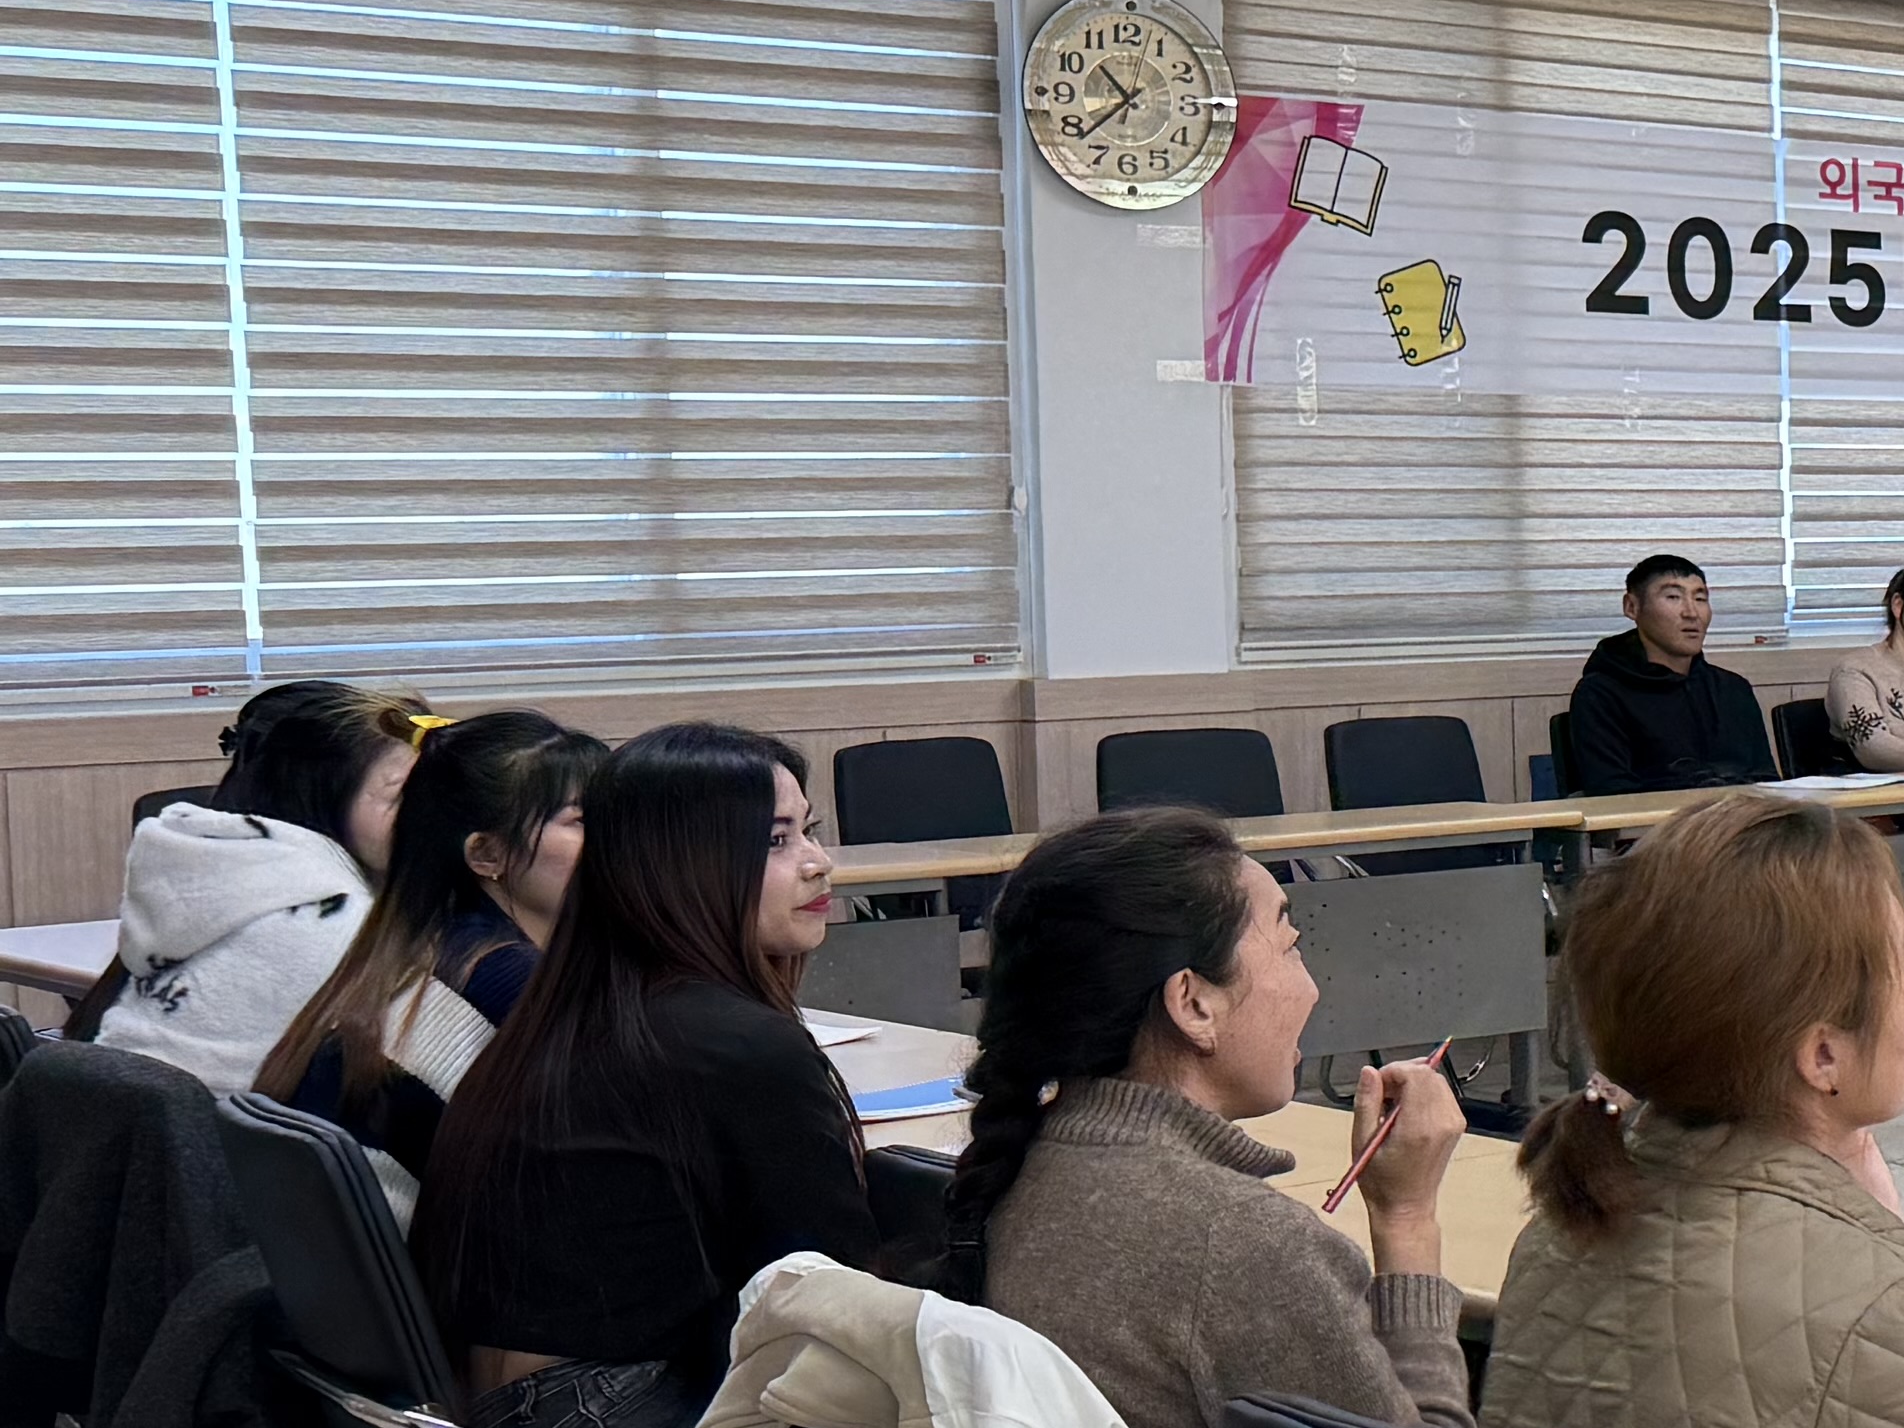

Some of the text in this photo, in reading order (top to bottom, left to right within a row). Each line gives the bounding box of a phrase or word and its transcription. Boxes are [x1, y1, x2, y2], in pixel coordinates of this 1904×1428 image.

[1084, 28, 1105, 50] 11
[1112, 23, 1142, 46] 12
[1156, 37, 1164, 57] 1
[1058, 52, 1084, 74] 10
[1172, 61, 1194, 83] 2
[1053, 81, 1075, 104] 9
[1170, 126, 1190, 147] 4
[1088, 144, 1110, 168] 7
[1117, 153, 1138, 175] 6
[1149, 149, 1170, 171] 5
